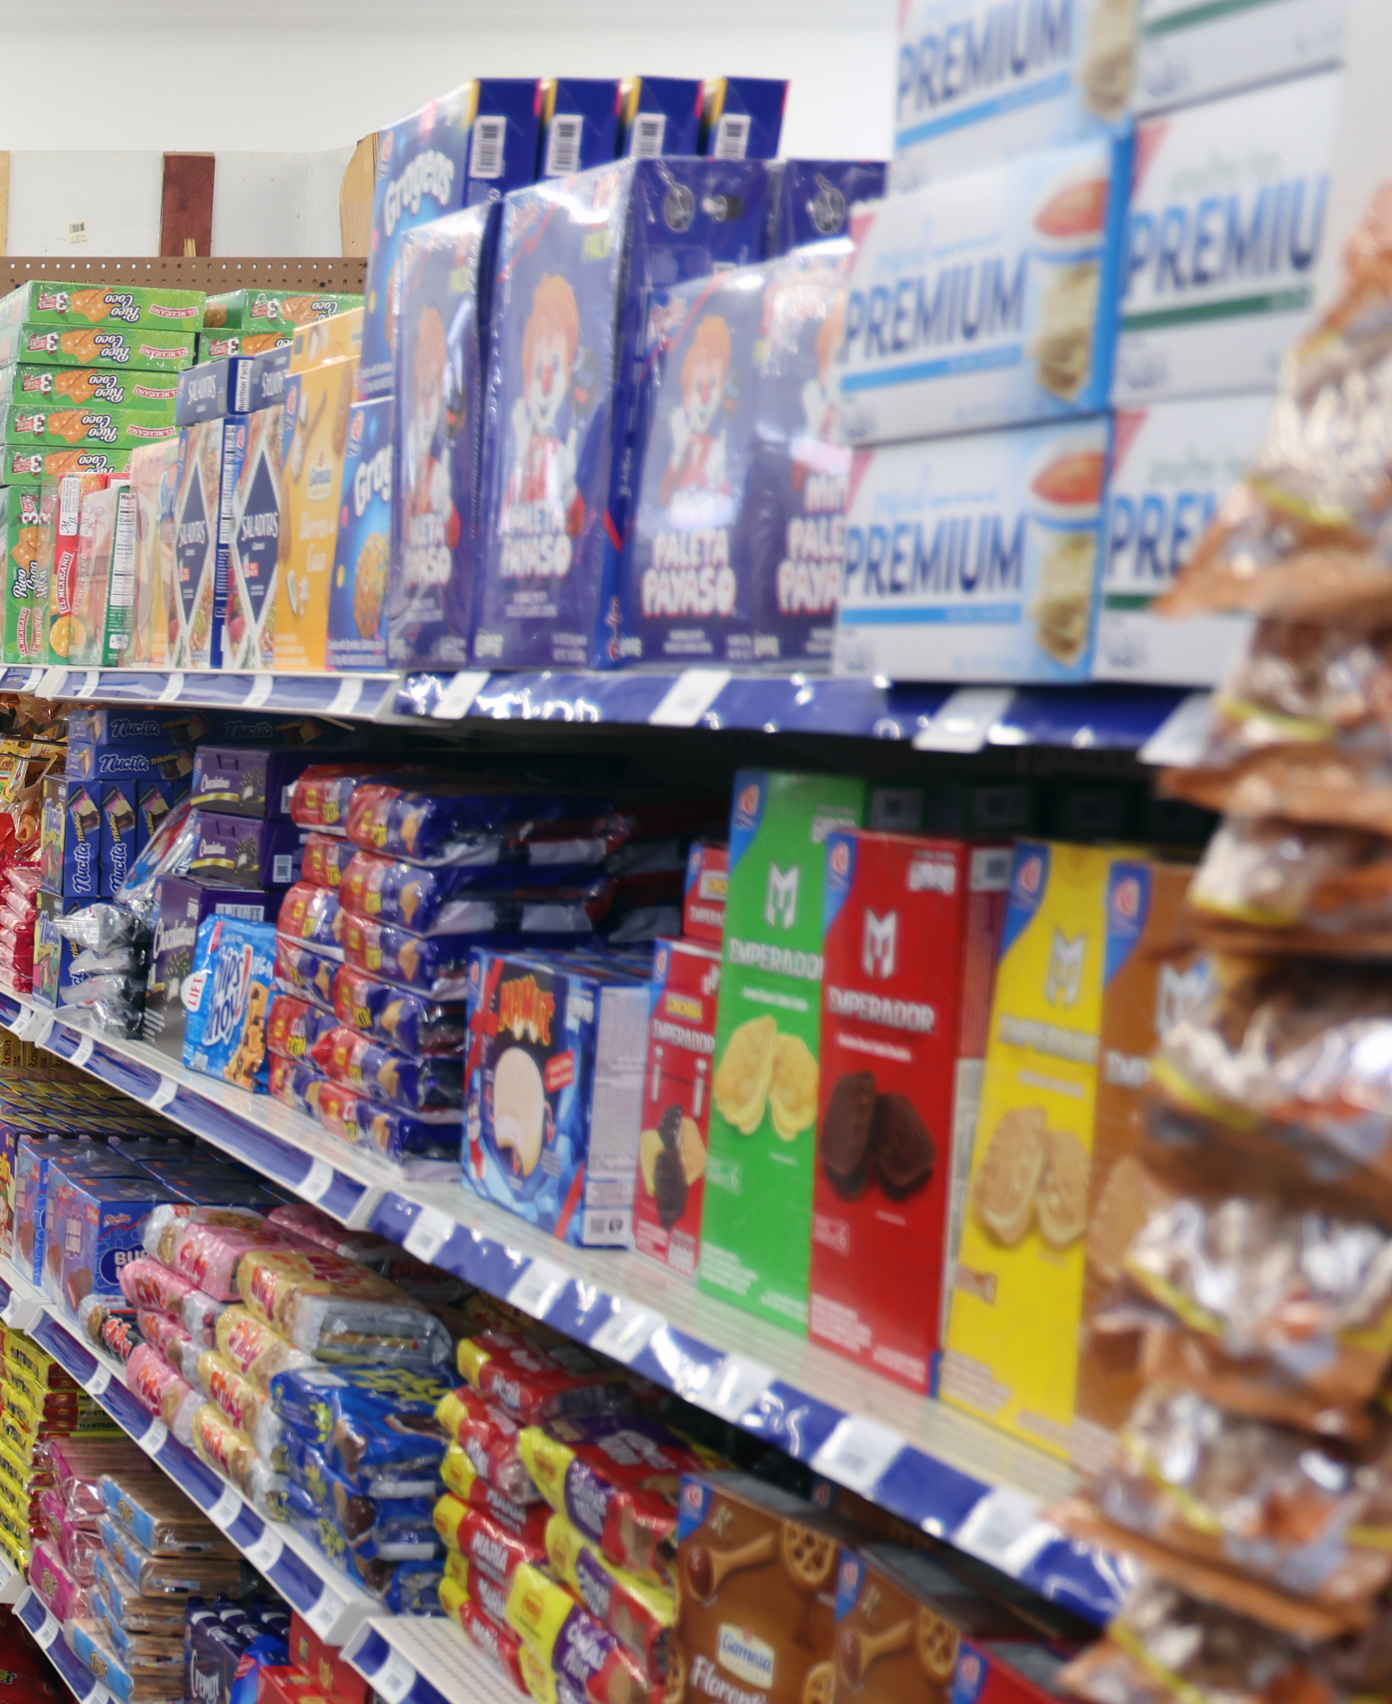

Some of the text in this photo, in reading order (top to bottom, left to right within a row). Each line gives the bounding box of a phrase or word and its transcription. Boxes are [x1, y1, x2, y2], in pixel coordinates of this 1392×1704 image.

[896, 0, 1072, 114] PREMIUM
[384, 149, 455, 239] Grageas
[1126, 174, 1331, 298] PREMIU
[104, 293, 134, 305] Coco
[110, 306, 140, 323] Rico
[843, 250, 1028, 363] PREMIUM
[236, 381, 247, 412] Nutrition
[81, 415, 111, 426] Coco
[88, 427, 118, 442] Rico
[78, 455, 108, 467] Coco
[178, 520, 206, 547] SALADITAS
[241, 512, 279, 541] SALADITAS
[786, 518, 843, 561] PALE
[499, 534, 572, 581] PAYASO
[652, 528, 729, 569] PALETA
[842, 510, 1026, 597] PREMIUM
[13, 568, 27, 599] Rico
[58, 551, 74, 596] MEXICANO
[641, 566, 738, 617] PAYASO
[111, 719, 161, 739] Nucita
[99, 754, 150, 773] Nucita
[73, 841, 91, 895] Nucita
[187, 978, 203, 1006] LIFT
[827, 987, 936, 1033] EMPERADOR
[652, 1019, 715, 1054] EMPERADOR
[721, 1630, 773, 1676] Gamesa
